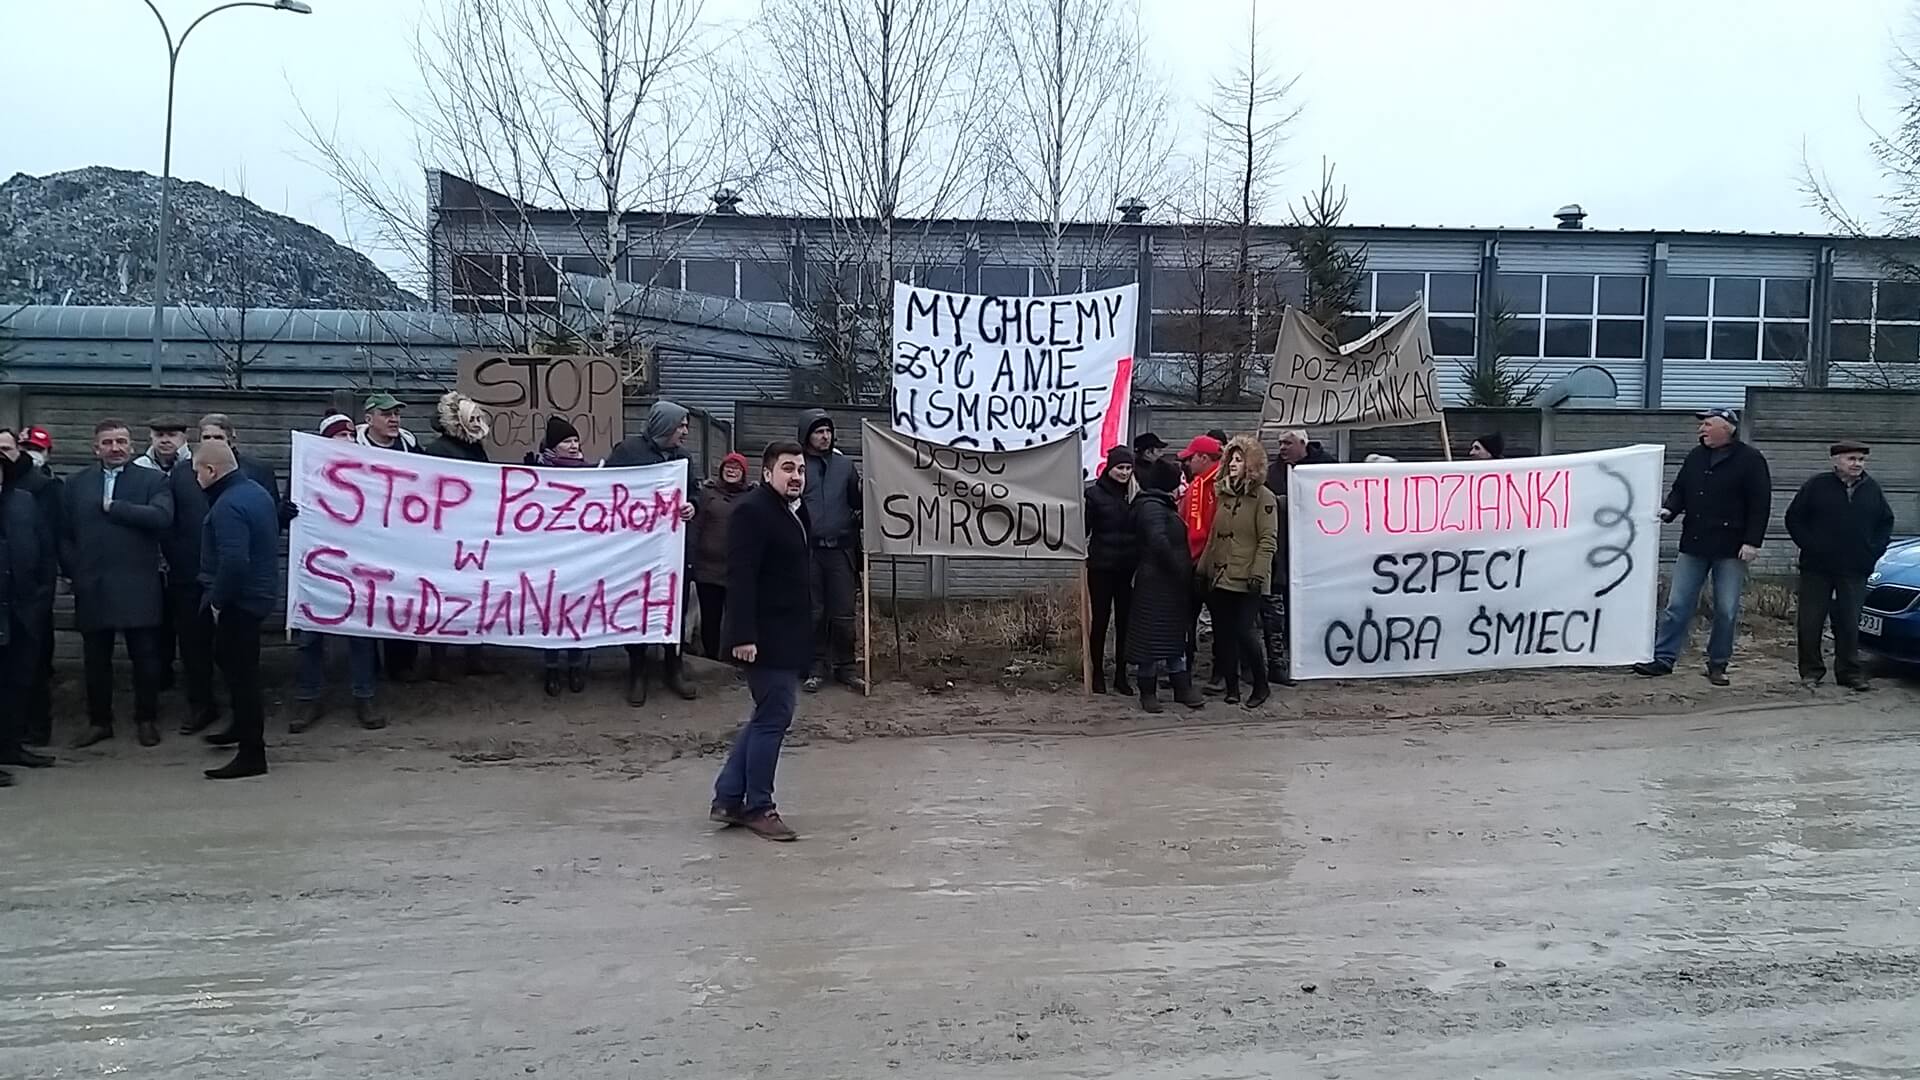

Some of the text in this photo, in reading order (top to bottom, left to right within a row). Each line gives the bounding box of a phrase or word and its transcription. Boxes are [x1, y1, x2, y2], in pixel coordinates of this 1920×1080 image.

[471, 357, 618, 413] STOP
[933, 472, 1009, 509] tego
[1317, 470, 1571, 535] STUDZIANKI
[881, 494, 1065, 551] SMRODU
[1372, 549, 1526, 595] SZPECI
[1323, 605, 1601, 666] GÓRA ŚMIECI
